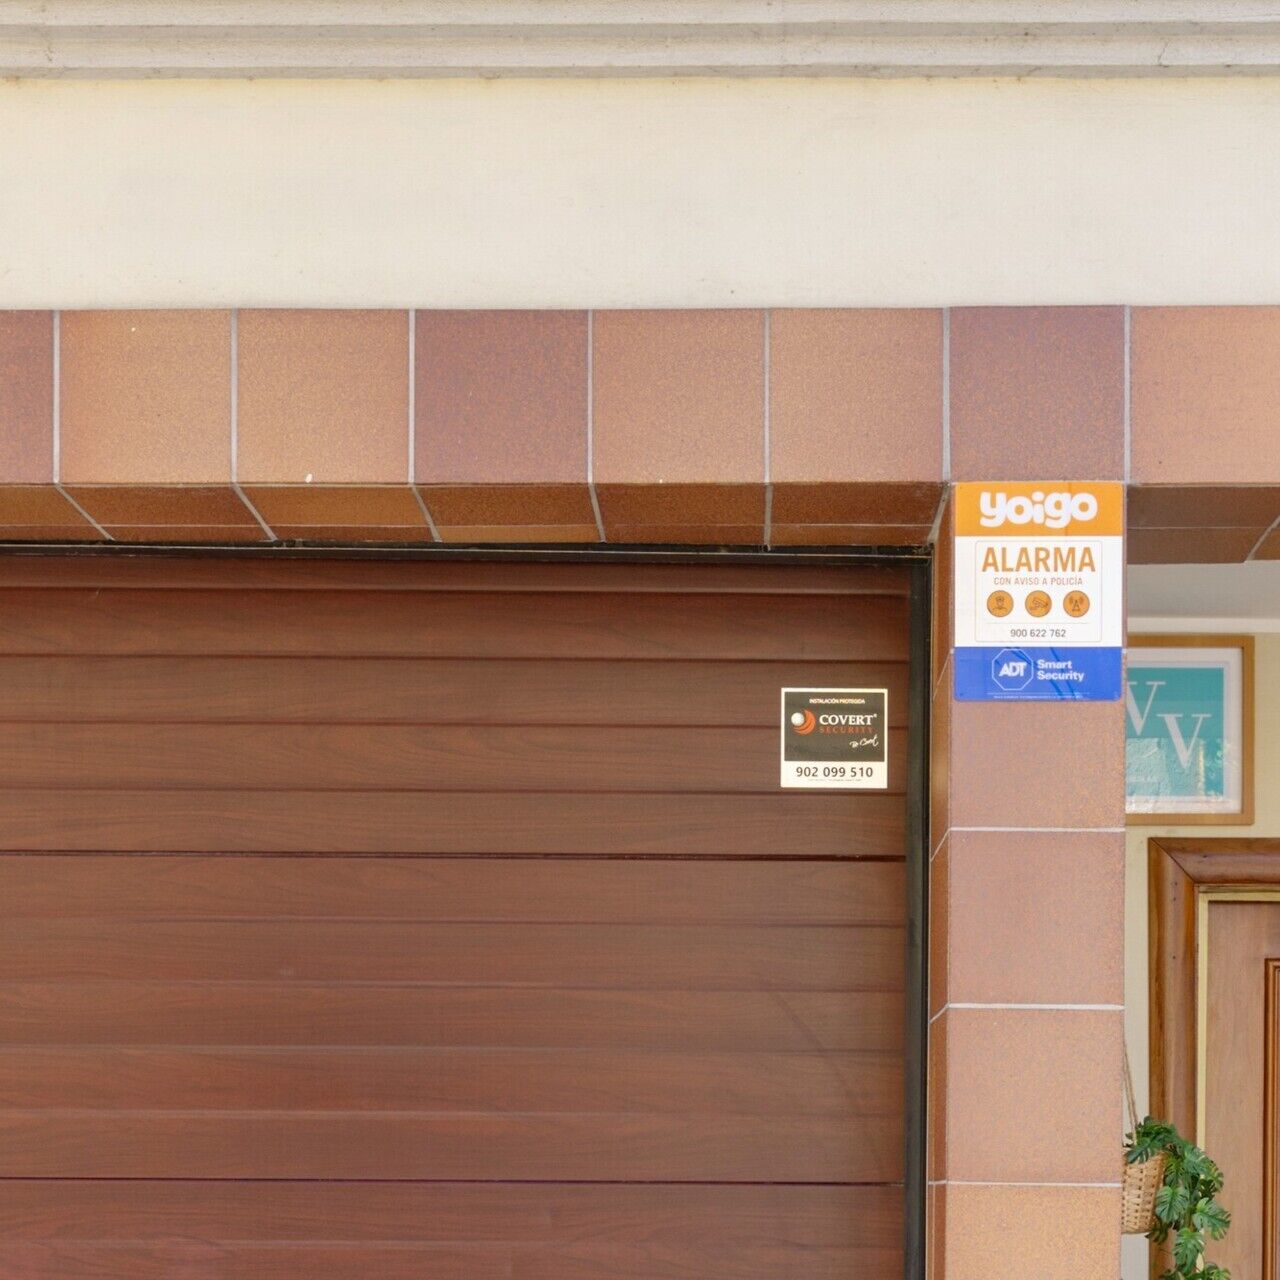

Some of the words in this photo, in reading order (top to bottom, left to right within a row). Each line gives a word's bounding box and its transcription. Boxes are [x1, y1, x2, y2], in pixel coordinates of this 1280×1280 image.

[980, 491, 1098, 529] yoigo
[982, 547, 1096, 572] ALARMA
[994, 577, 1011, 586] CON
[1014, 577, 1039, 586] AVISO
[1042, 577, 1048, 586] A
[1010, 629, 1027, 638] 900
[1030, 629, 1047, 638] 622
[1050, 629, 1066, 638] 762
[999, 662, 1026, 677] ADT
[1037, 660, 1072, 669] Smart
[1037, 670, 1084, 681] Security
[796, 766, 819, 777] 902
[823, 766, 846, 777] 099
[850, 766, 873, 777] 510
